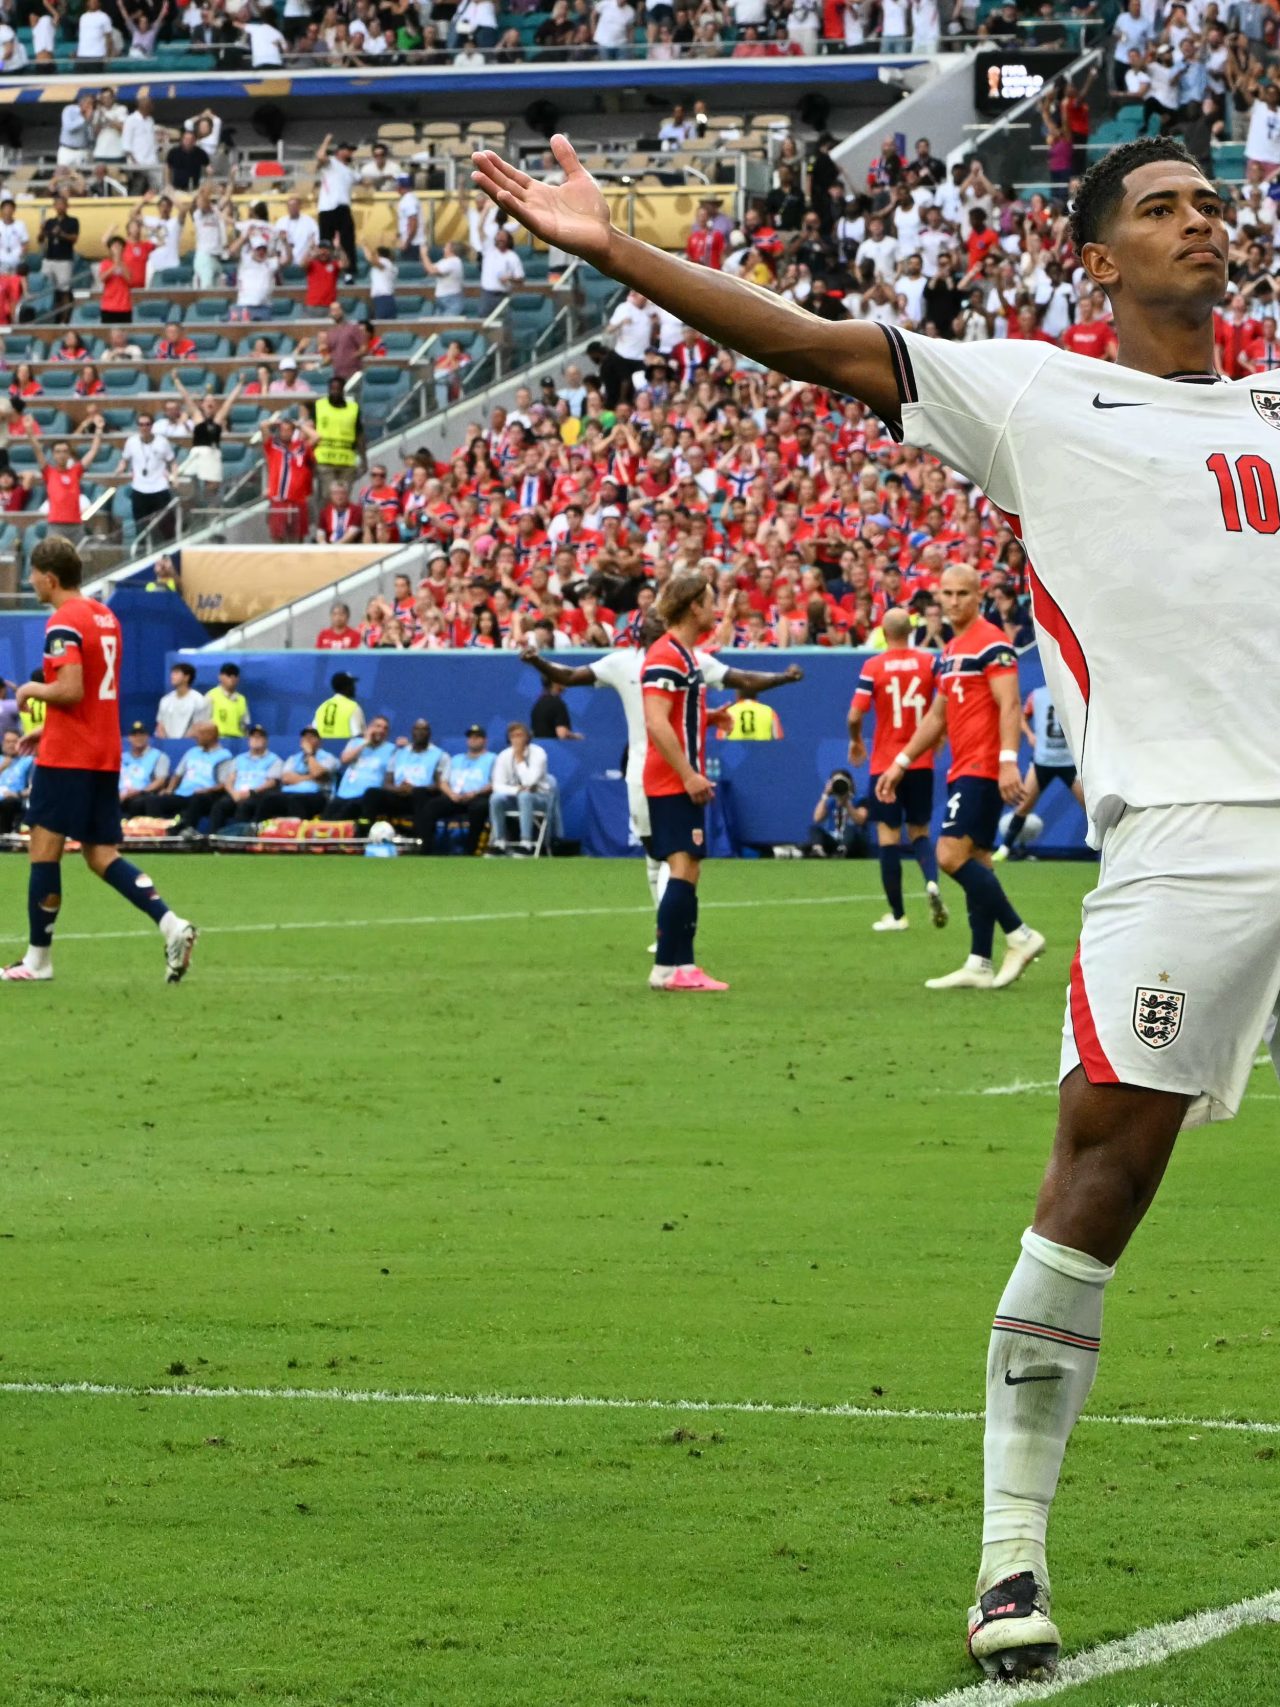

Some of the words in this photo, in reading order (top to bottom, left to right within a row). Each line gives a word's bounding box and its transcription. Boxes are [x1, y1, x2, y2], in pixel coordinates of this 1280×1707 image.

[99, 635, 117, 700] 8
[885, 676, 927, 729] 14
[951, 677, 965, 704] 4
[946, 791, 961, 819] 4
